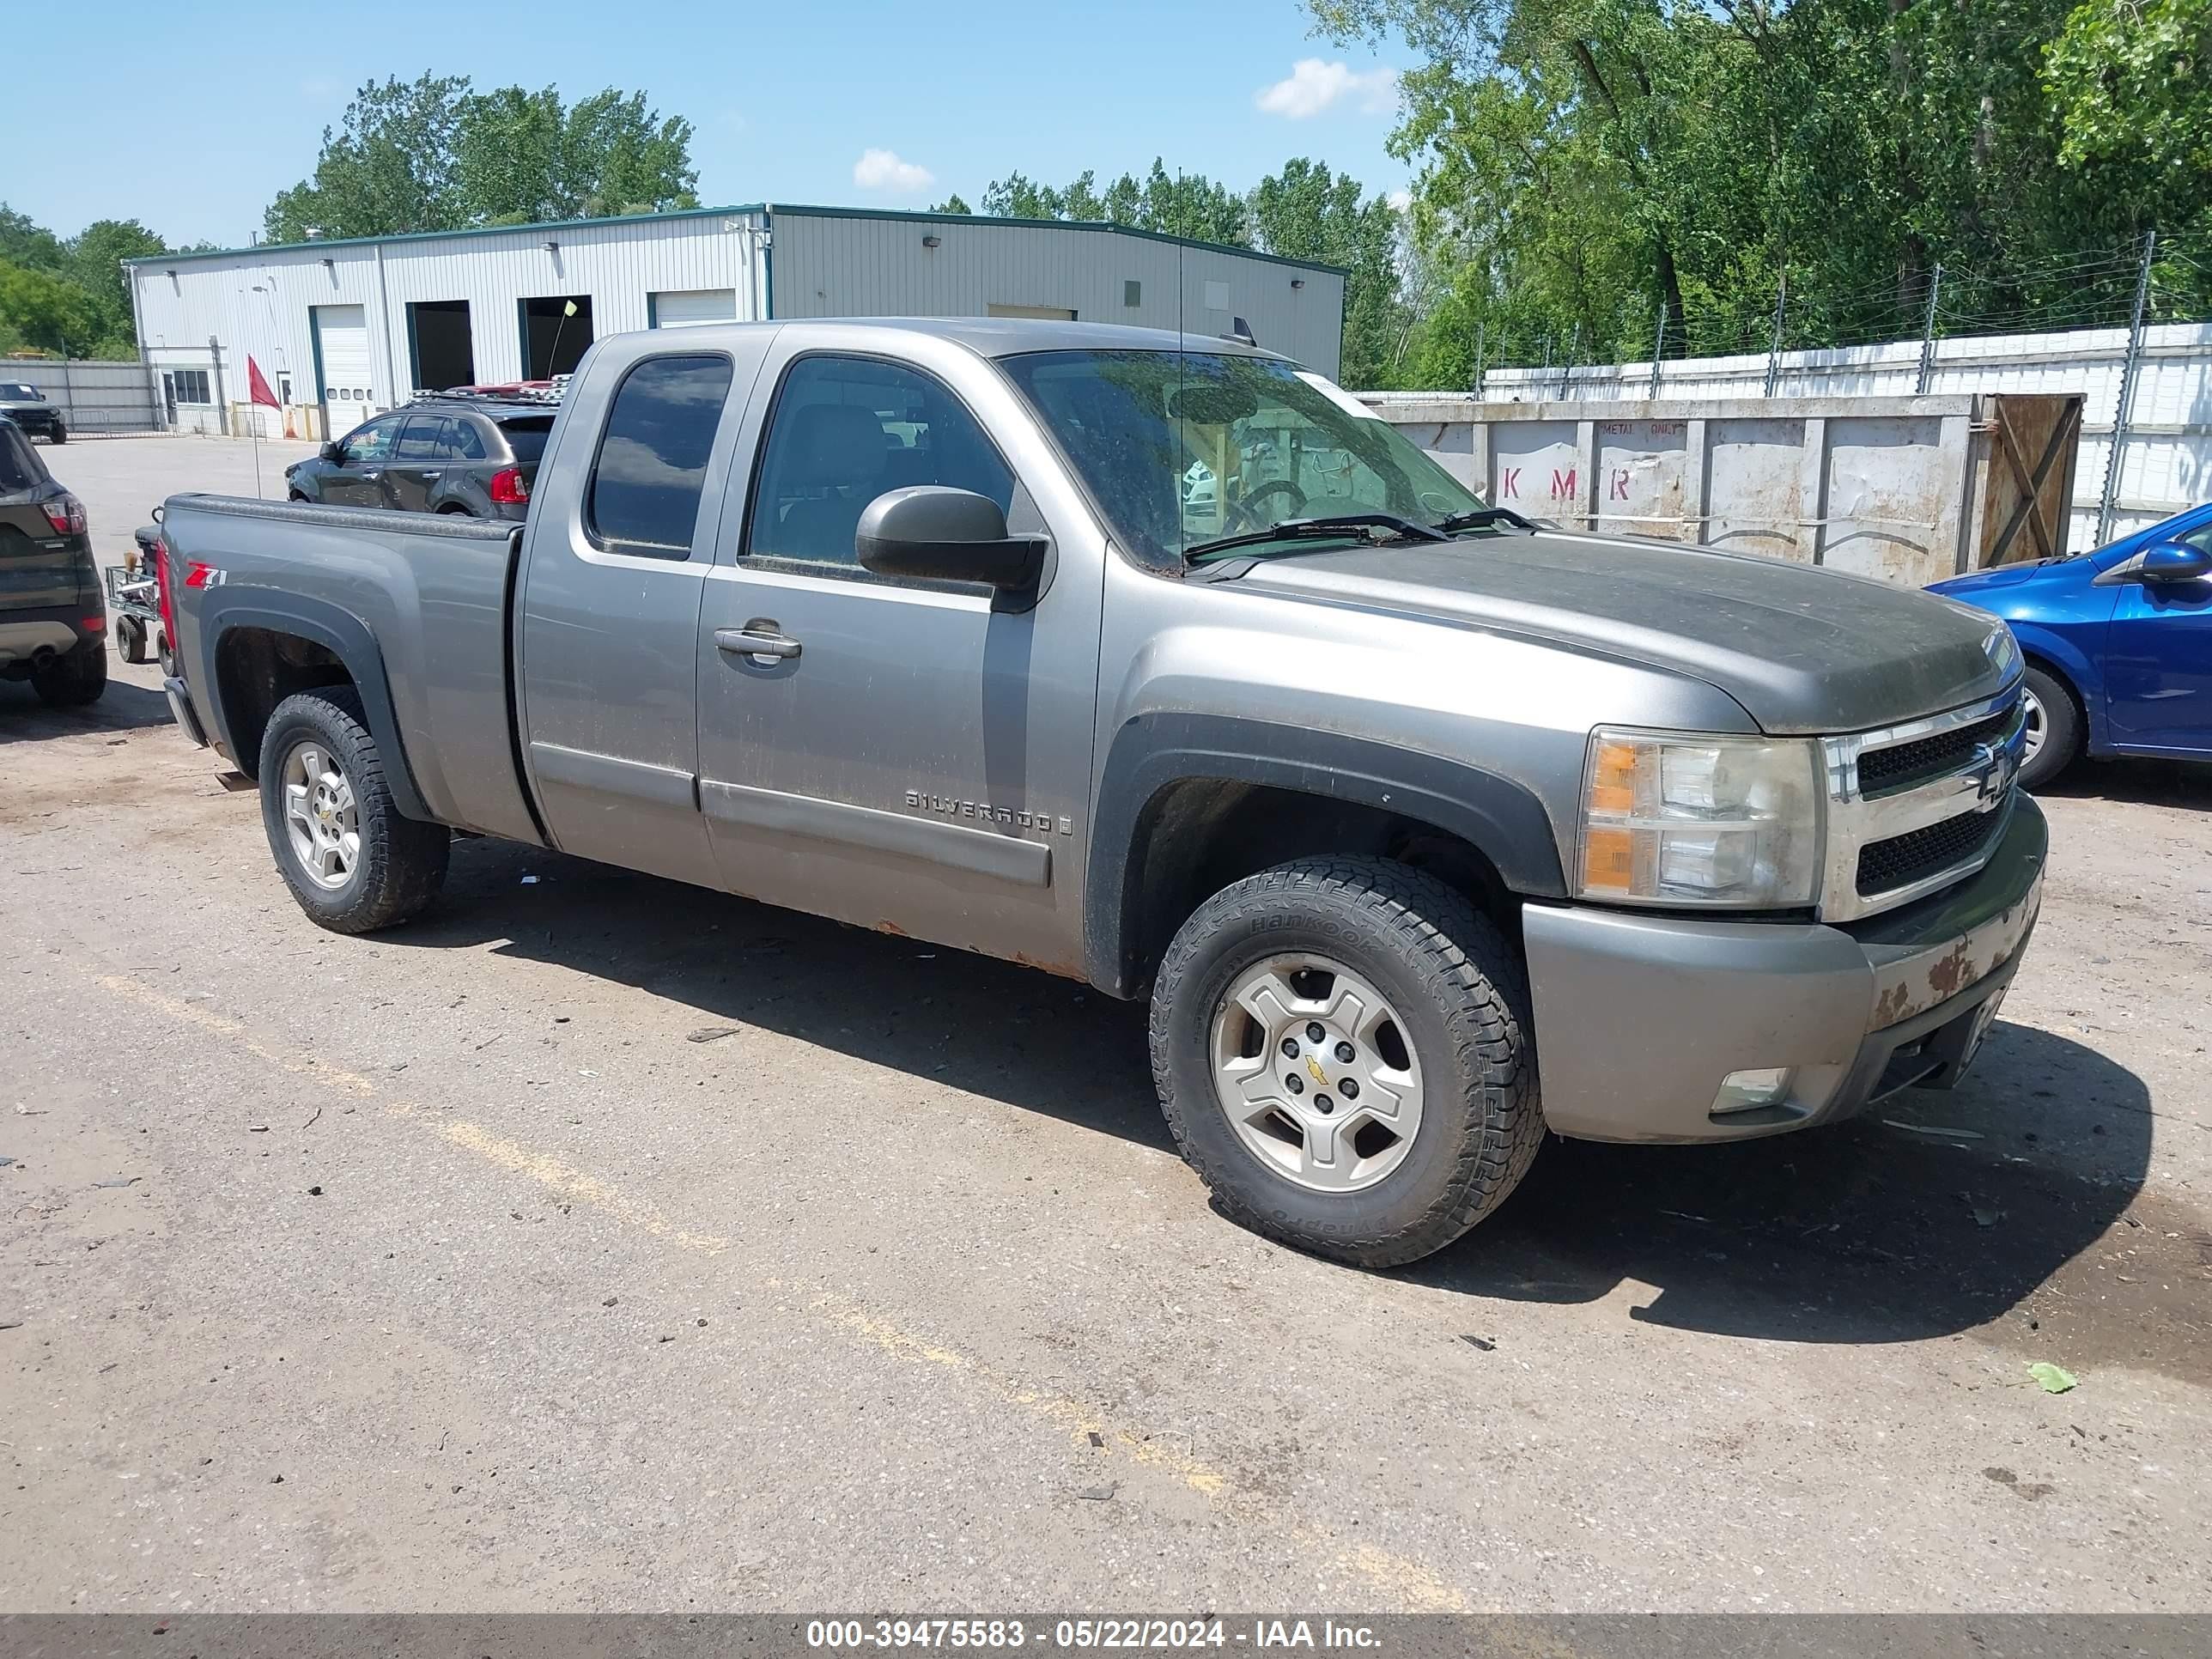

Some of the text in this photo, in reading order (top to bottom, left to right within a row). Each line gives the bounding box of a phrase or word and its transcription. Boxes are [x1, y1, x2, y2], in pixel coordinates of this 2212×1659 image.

[1504, 467, 1629, 501] K M R
[186, 561, 228, 587] Z71
[906, 791, 1051, 830] SILVERADO
